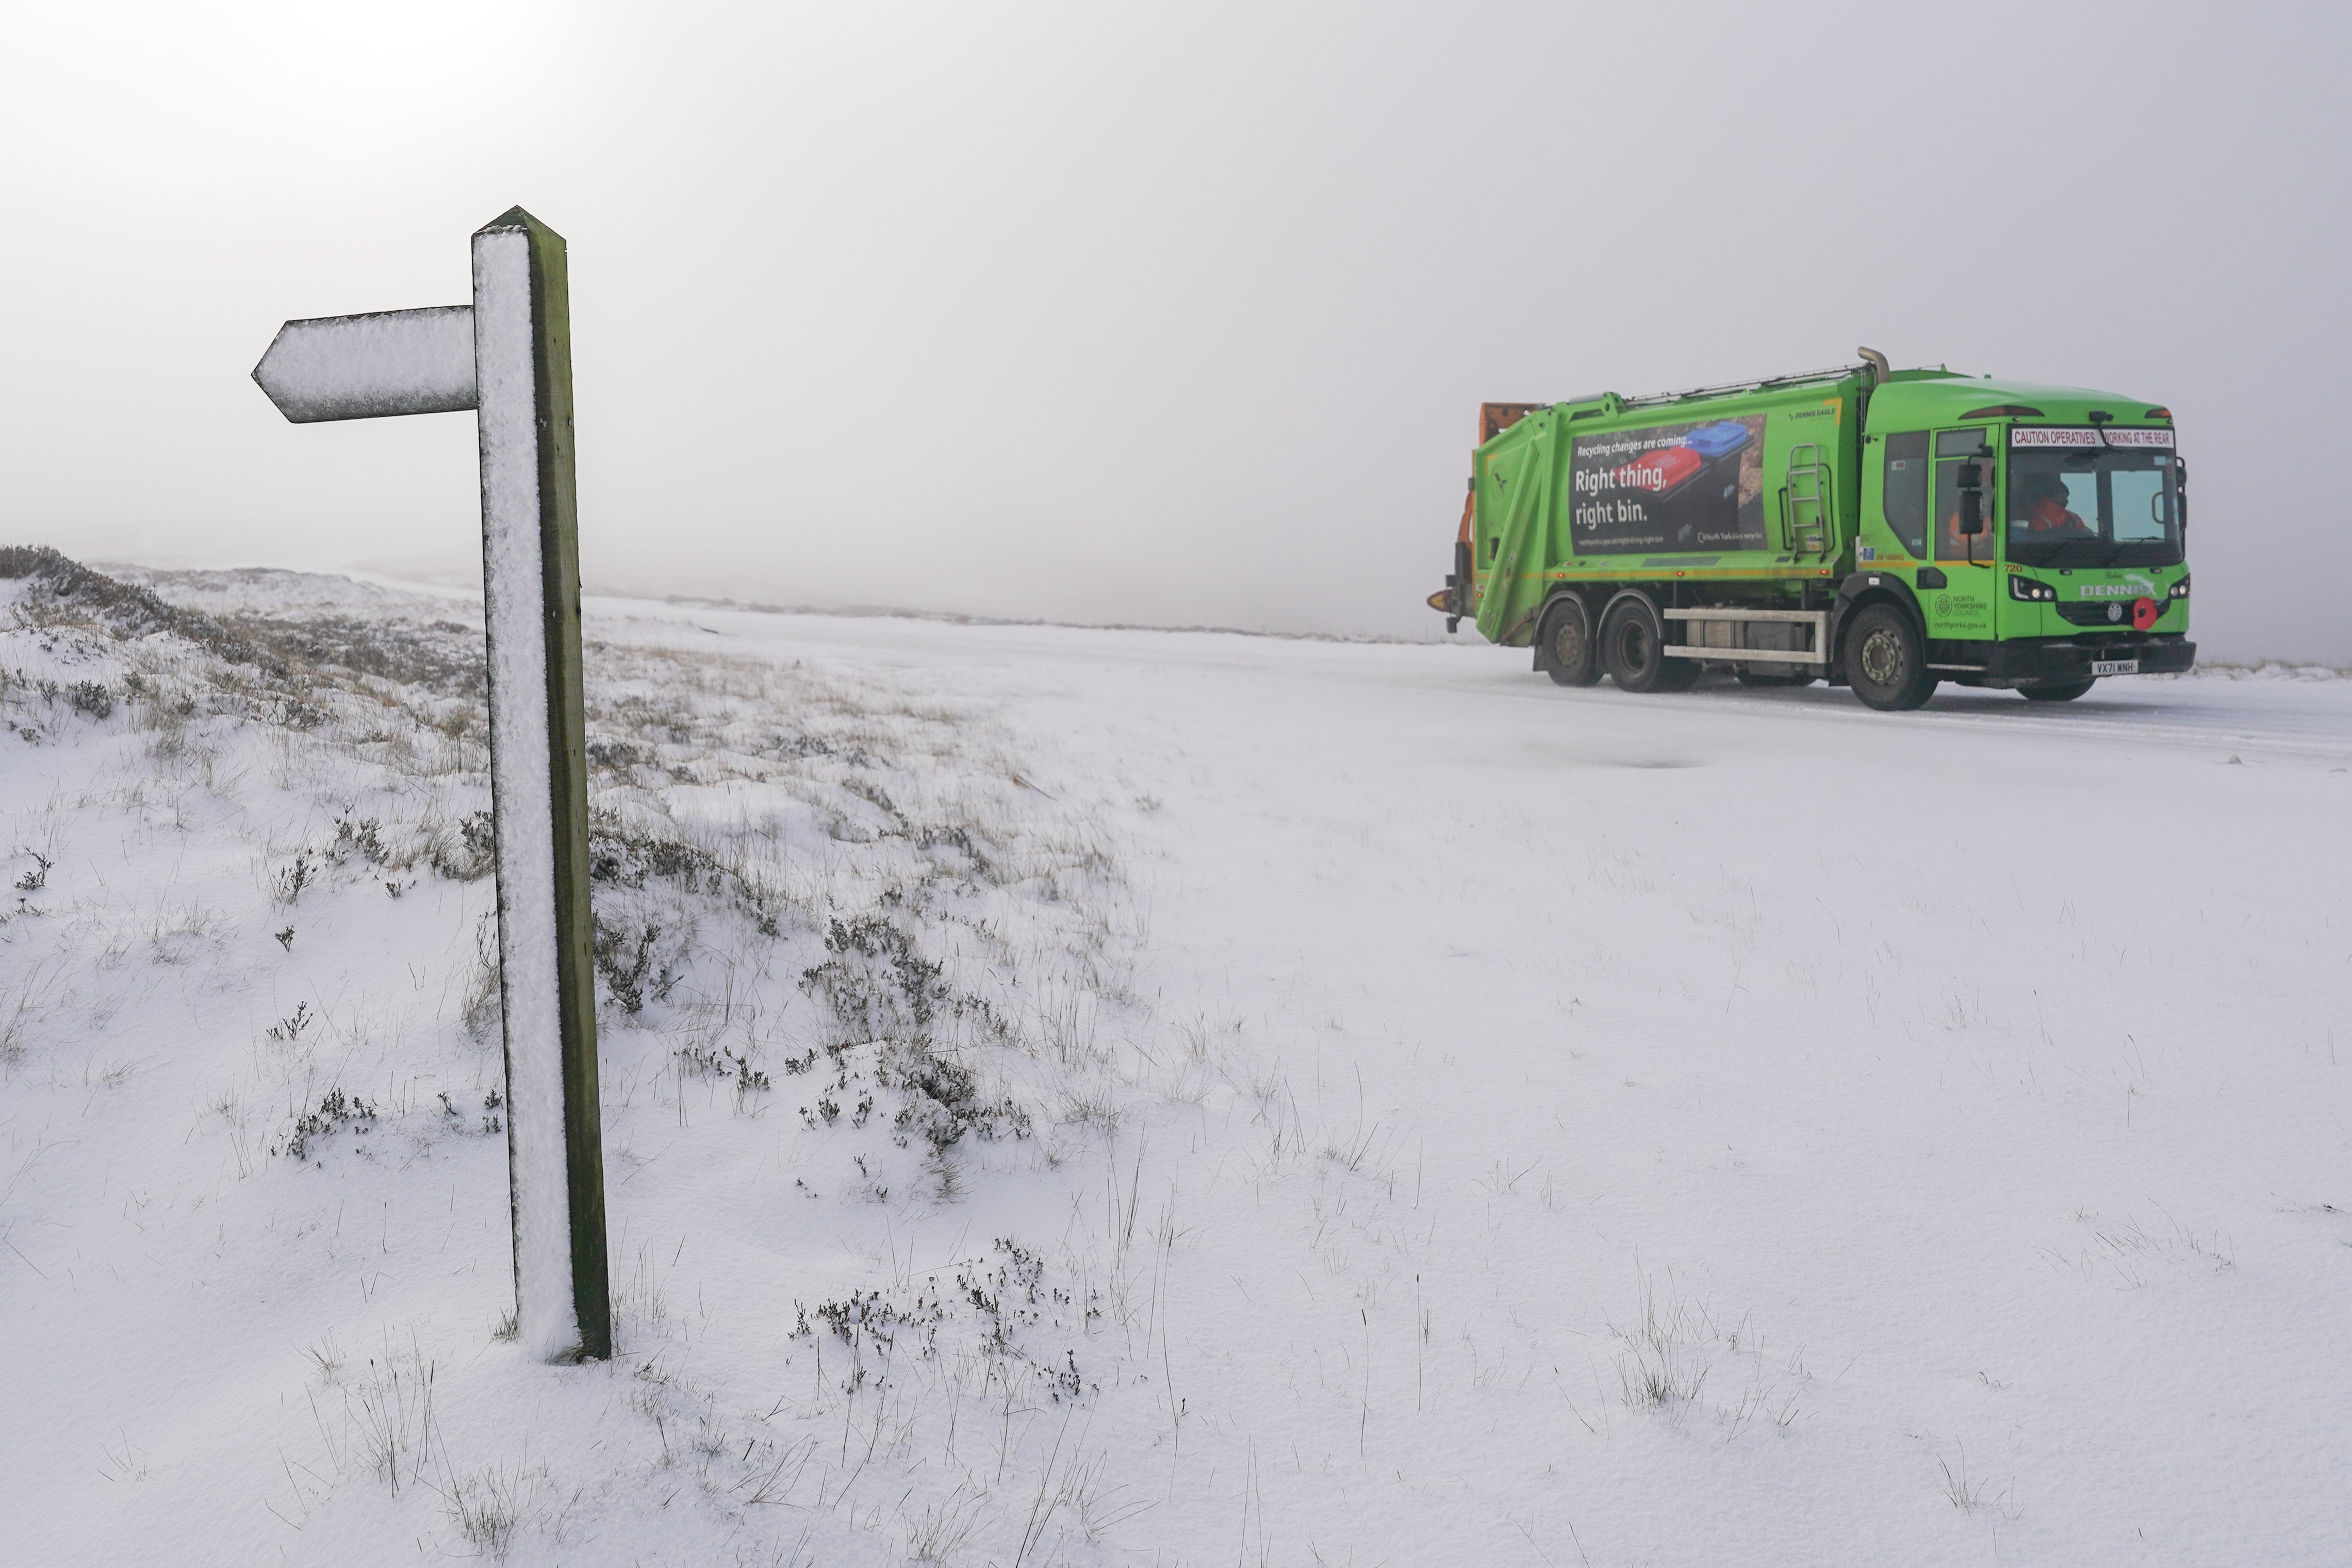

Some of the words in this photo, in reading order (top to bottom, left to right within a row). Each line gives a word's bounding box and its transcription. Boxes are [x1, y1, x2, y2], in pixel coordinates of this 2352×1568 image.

[2015, 431, 2049, 444] CAUTION
[2050, 431, 2096, 444] OPERATIVES
[2104, 432, 2132, 444] WORKING
[2134, 432, 2141, 443] AT
[2141, 432, 2153, 444] THE
[2154, 432, 2169, 444] REAR
[1577, 443, 1610, 458] Recycling
[1611, 441, 1641, 454] changes
[1643, 439, 1655, 449] are
[1657, 435, 1693, 448] coming...
[1575, 467, 1616, 497] Right
[1619, 464, 1667, 492] thing,
[1576, 501, 1614, 531] right
[1617, 499, 1648, 522] bin.
[2004, 564, 2022, 572] 720
[2080, 585, 2151, 596] DENNIS
[1934, 621, 1987, 630] northyorks.gov.uk
[2097, 663, 2115, 673] VX71
[2117, 662, 2133, 672] WNH
